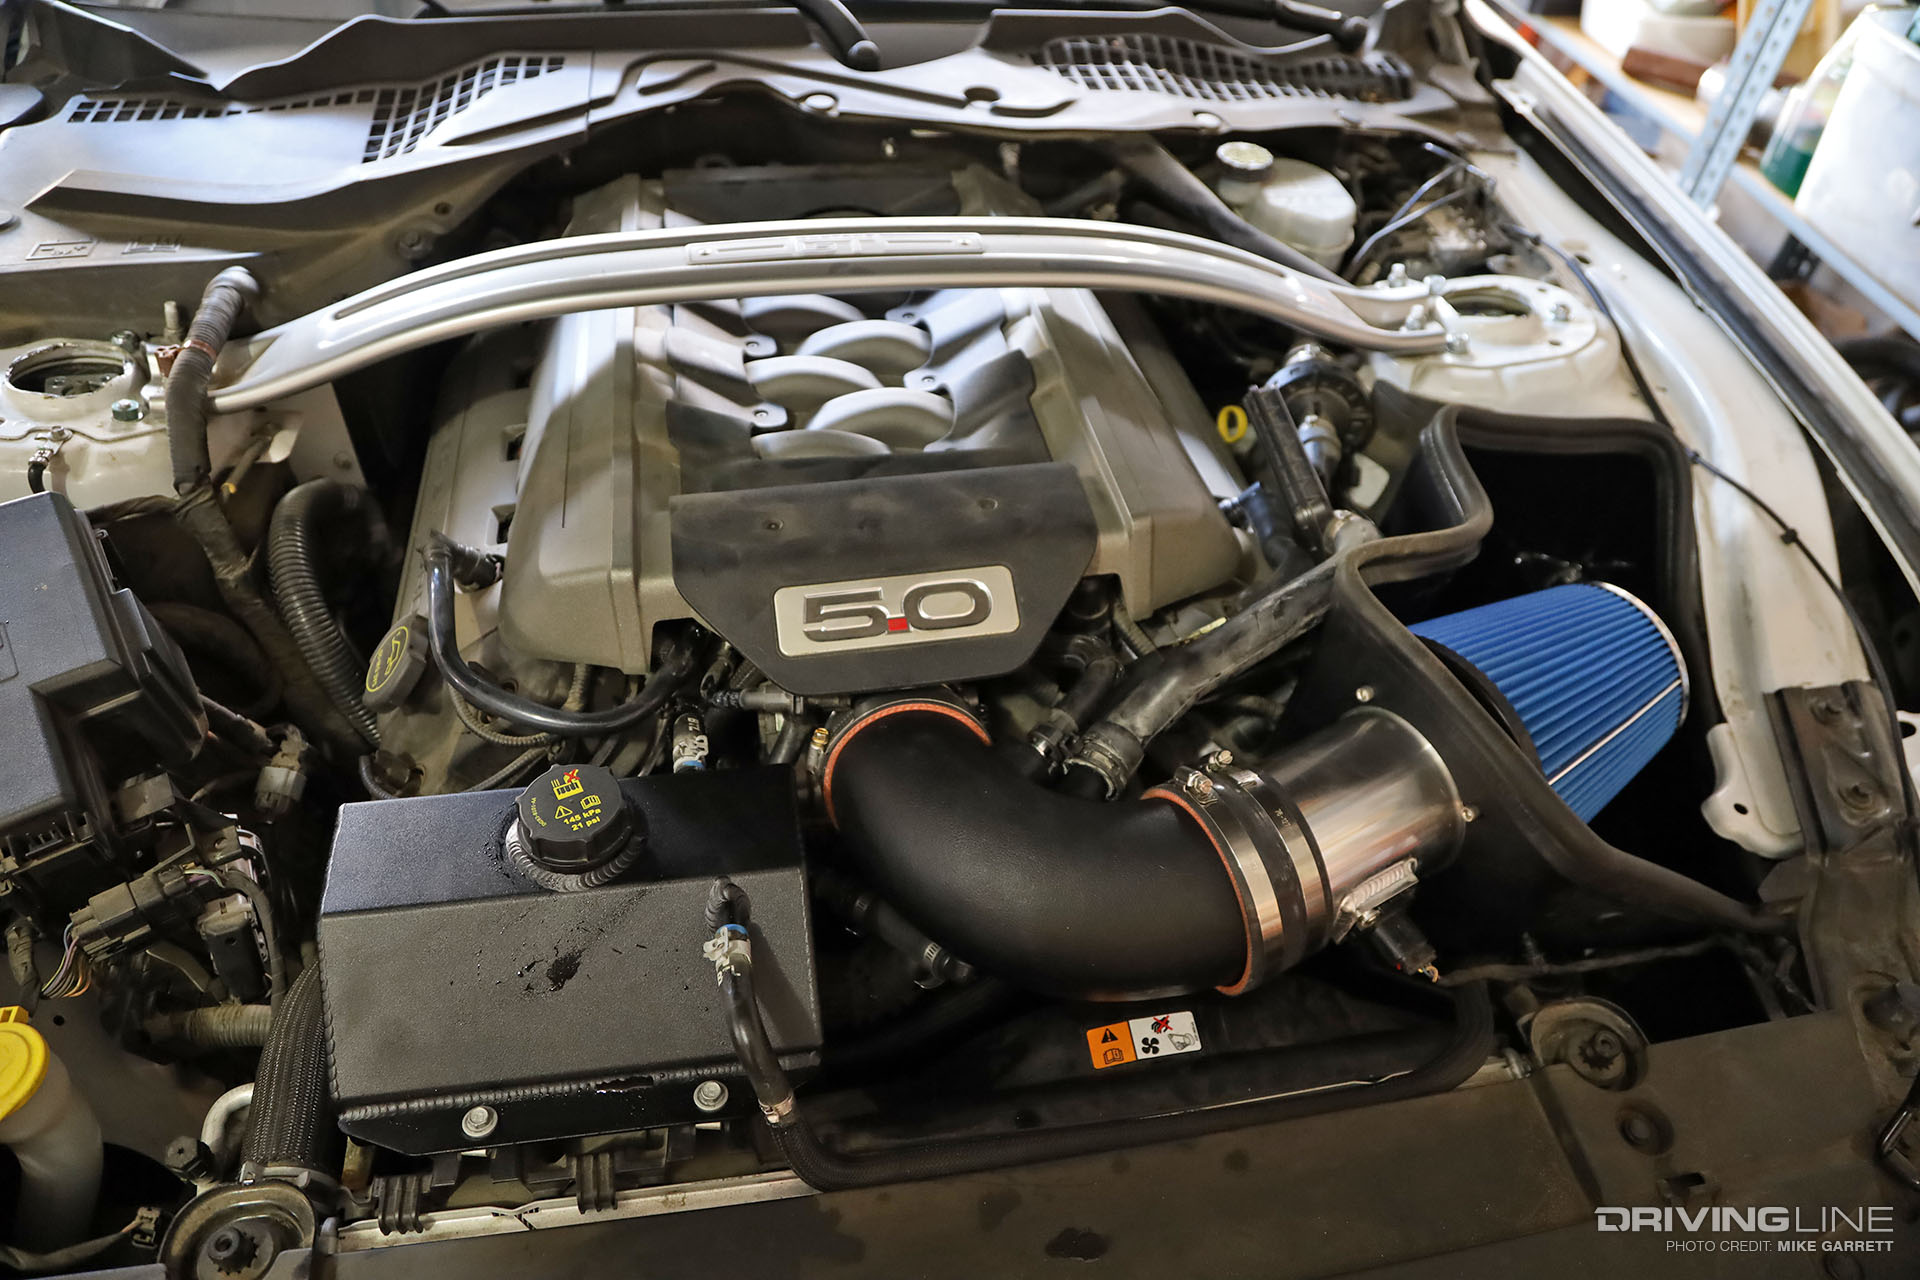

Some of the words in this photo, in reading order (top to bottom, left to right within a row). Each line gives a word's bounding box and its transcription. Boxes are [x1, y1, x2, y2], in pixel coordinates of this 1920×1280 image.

[803, 578, 992, 642] 5.0
[564, 815, 581, 824] 145
[583, 809, 601, 818] kPa
[572, 823, 583, 831] 21
[585, 816, 600, 827] psi
